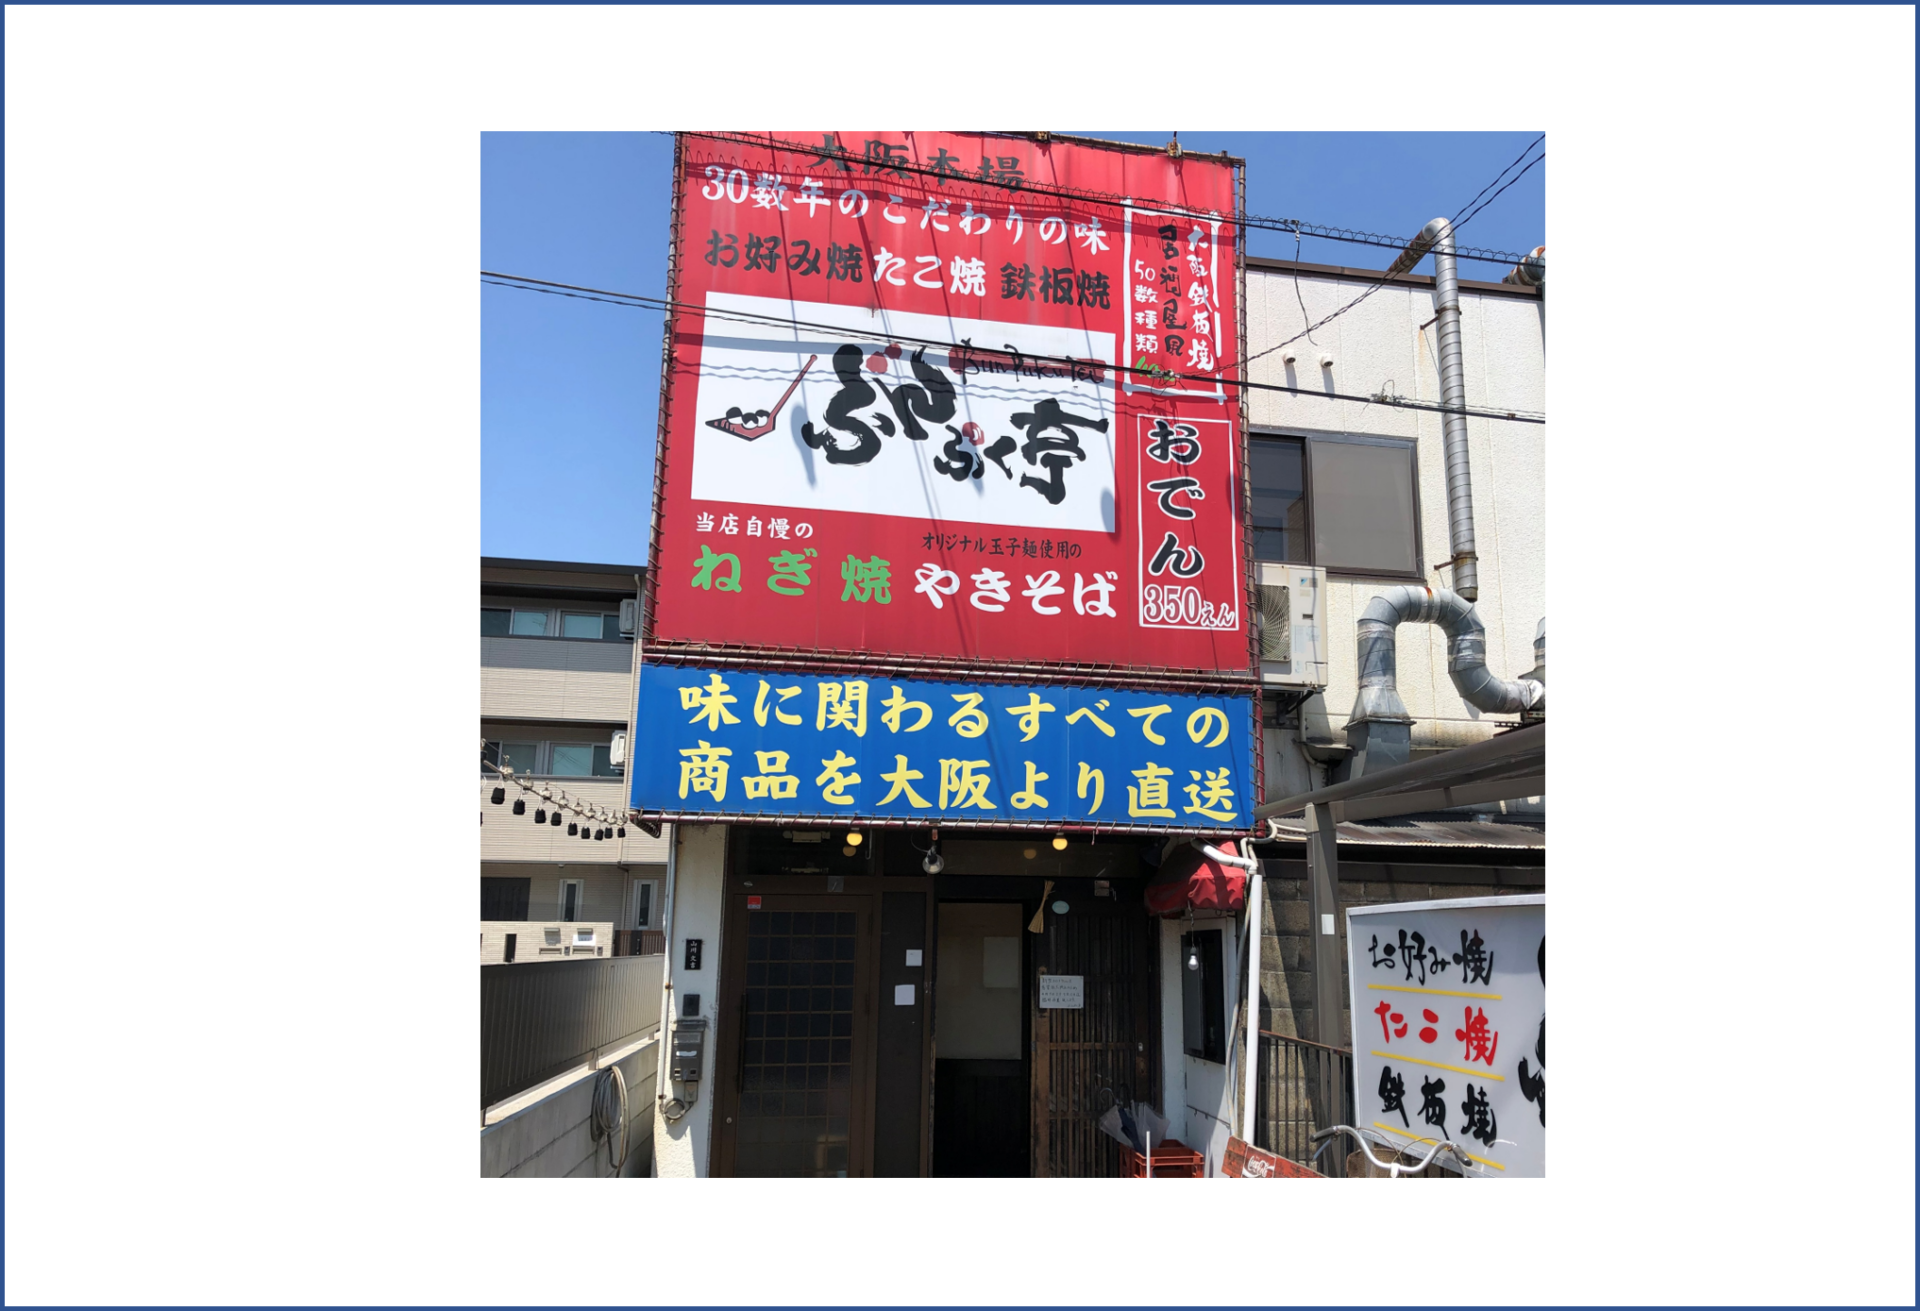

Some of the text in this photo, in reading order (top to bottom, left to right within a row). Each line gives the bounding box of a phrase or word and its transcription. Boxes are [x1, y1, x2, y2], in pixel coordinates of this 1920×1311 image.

[806, 134, 1025, 193] 大阪本場
[702, 164, 1110, 256] 30数年のこだわりの味
[704, 228, 1112, 311] お好み焼 たこ焼 鉄板焼
[695, 513, 815, 540] 当店自慢の
[1146, 419, 1206, 579] おでん
[691, 544, 893, 605] ねぎ焼
[921, 532, 1082, 560] オリジナル玉子麺使用の
[914, 562, 1118, 618] やきそば
[1143, 583, 1236, 627] 350えん
[678, 673, 1231, 749] 味に関わるすべての
[678, 740, 1238, 822] 商品を大阪より直送
